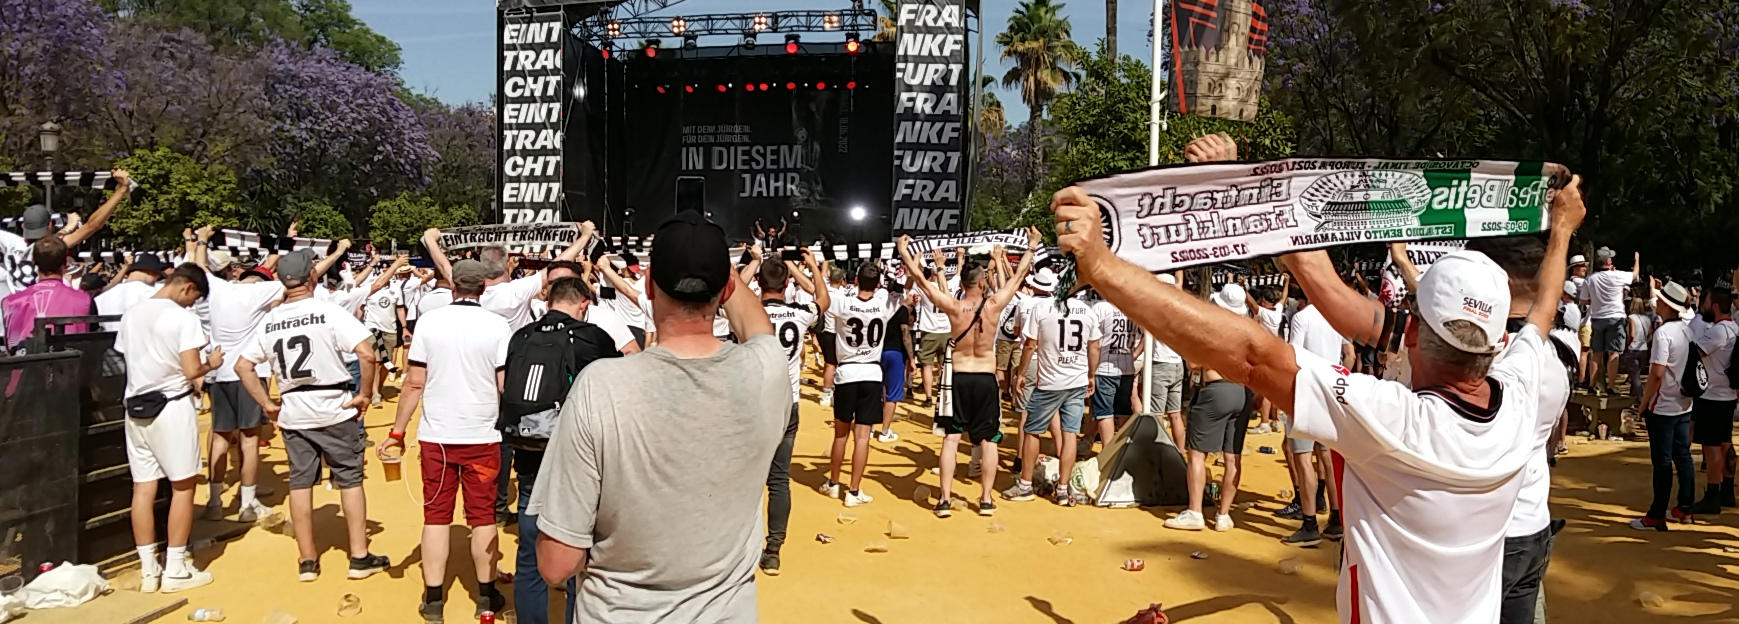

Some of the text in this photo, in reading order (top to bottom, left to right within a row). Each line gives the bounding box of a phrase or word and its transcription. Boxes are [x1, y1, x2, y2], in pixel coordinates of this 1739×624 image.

[504, 21, 561, 44] EINT
[897, 33, 964, 56] NKF
[504, 75, 561, 97] CHT
[504, 102, 561, 123] EINT
[896, 91, 959, 115] FRA
[895, 120, 961, 144] NKF
[504, 155, 561, 176] CHT
[681, 144, 802, 171] IN DIESEM
[503, 182, 560, 202] EINT
[739, 171, 801, 198] JAHR
[893, 179, 957, 202] FRA
[893, 207, 960, 231] NKF
[442, 230, 509, 248] EINTRACHT
[1462, 296, 1493, 315] SEVILLA
[265, 312, 327, 335] Eintracht
[845, 316, 884, 348] 30
[1057, 318, 1083, 352] 13
[272, 334, 316, 380] 12
[1332, 377, 1350, 405] pdp
